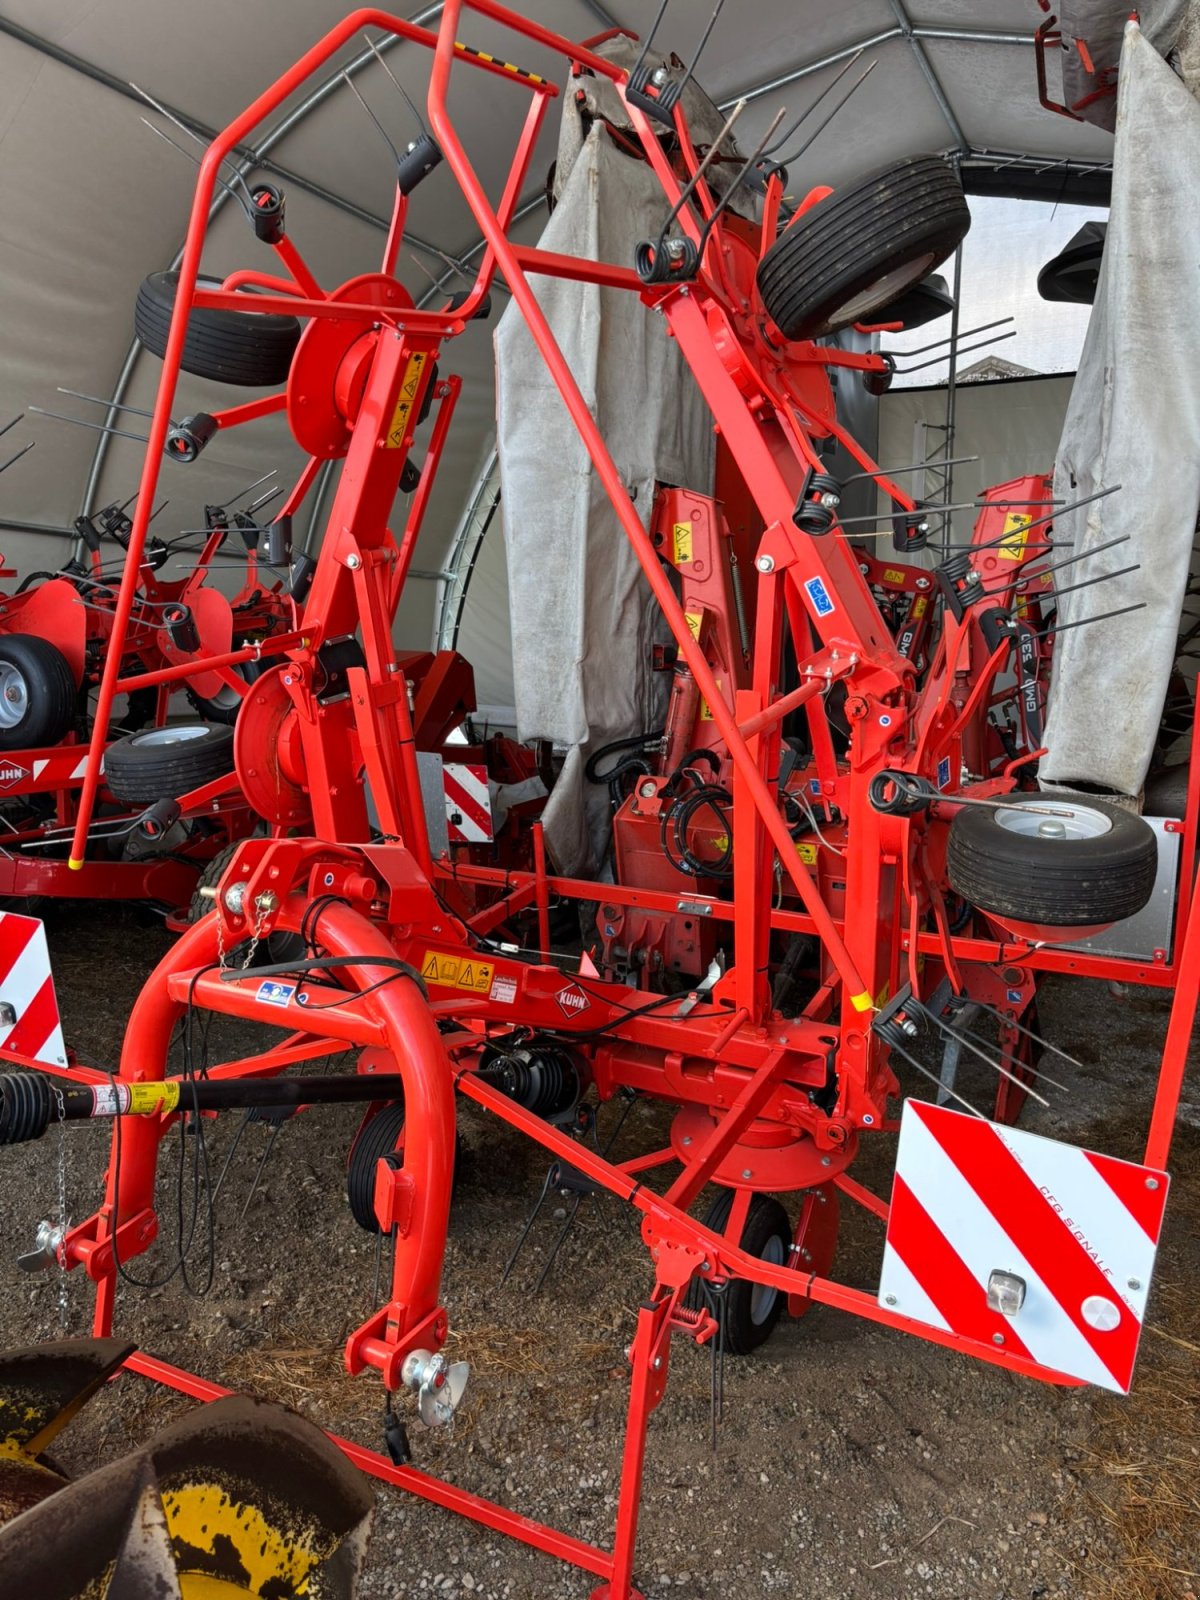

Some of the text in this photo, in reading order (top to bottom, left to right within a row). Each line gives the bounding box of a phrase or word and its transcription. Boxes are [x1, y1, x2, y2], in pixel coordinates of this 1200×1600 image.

[0, 769, 22, 780] UHN
[559, 992, 585, 1009] KUHN
[1039, 1185, 1114, 1278] CFG SIGNALE
